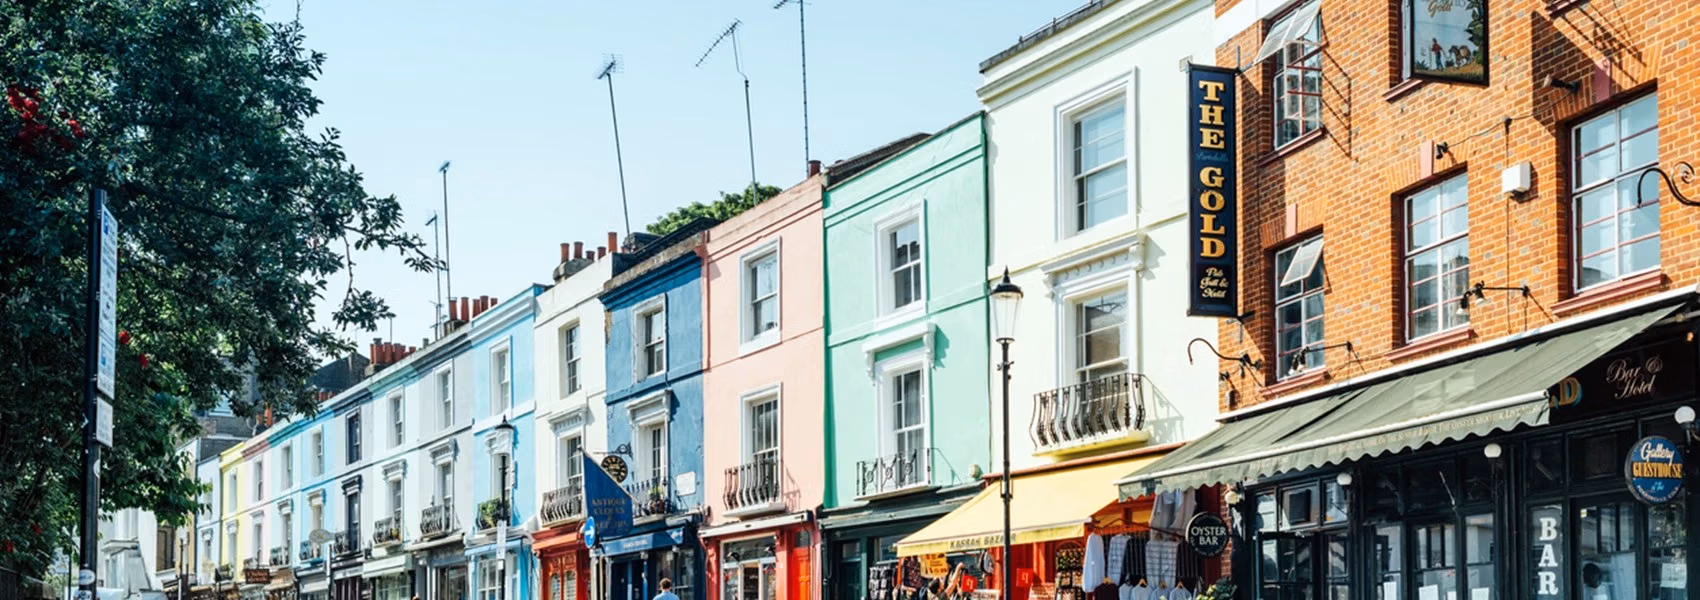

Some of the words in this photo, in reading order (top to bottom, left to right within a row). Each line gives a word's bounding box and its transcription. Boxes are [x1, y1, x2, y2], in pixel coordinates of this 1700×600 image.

[1198, 80, 1225, 149] THE
[1199, 166, 1226, 258] GOLD
[1606, 359, 1641, 382] Bar
[1614, 374, 1656, 400] Hotel
[1641, 442, 1675, 466] Gallery
[1633, 462, 1683, 478] GUESTHOUSE
[984, 533, 1016, 545] BAZAR
[1191, 526, 1226, 536] OYSTER
[1199, 536, 1219, 546] BAR
[1538, 517, 1559, 595] BAR
